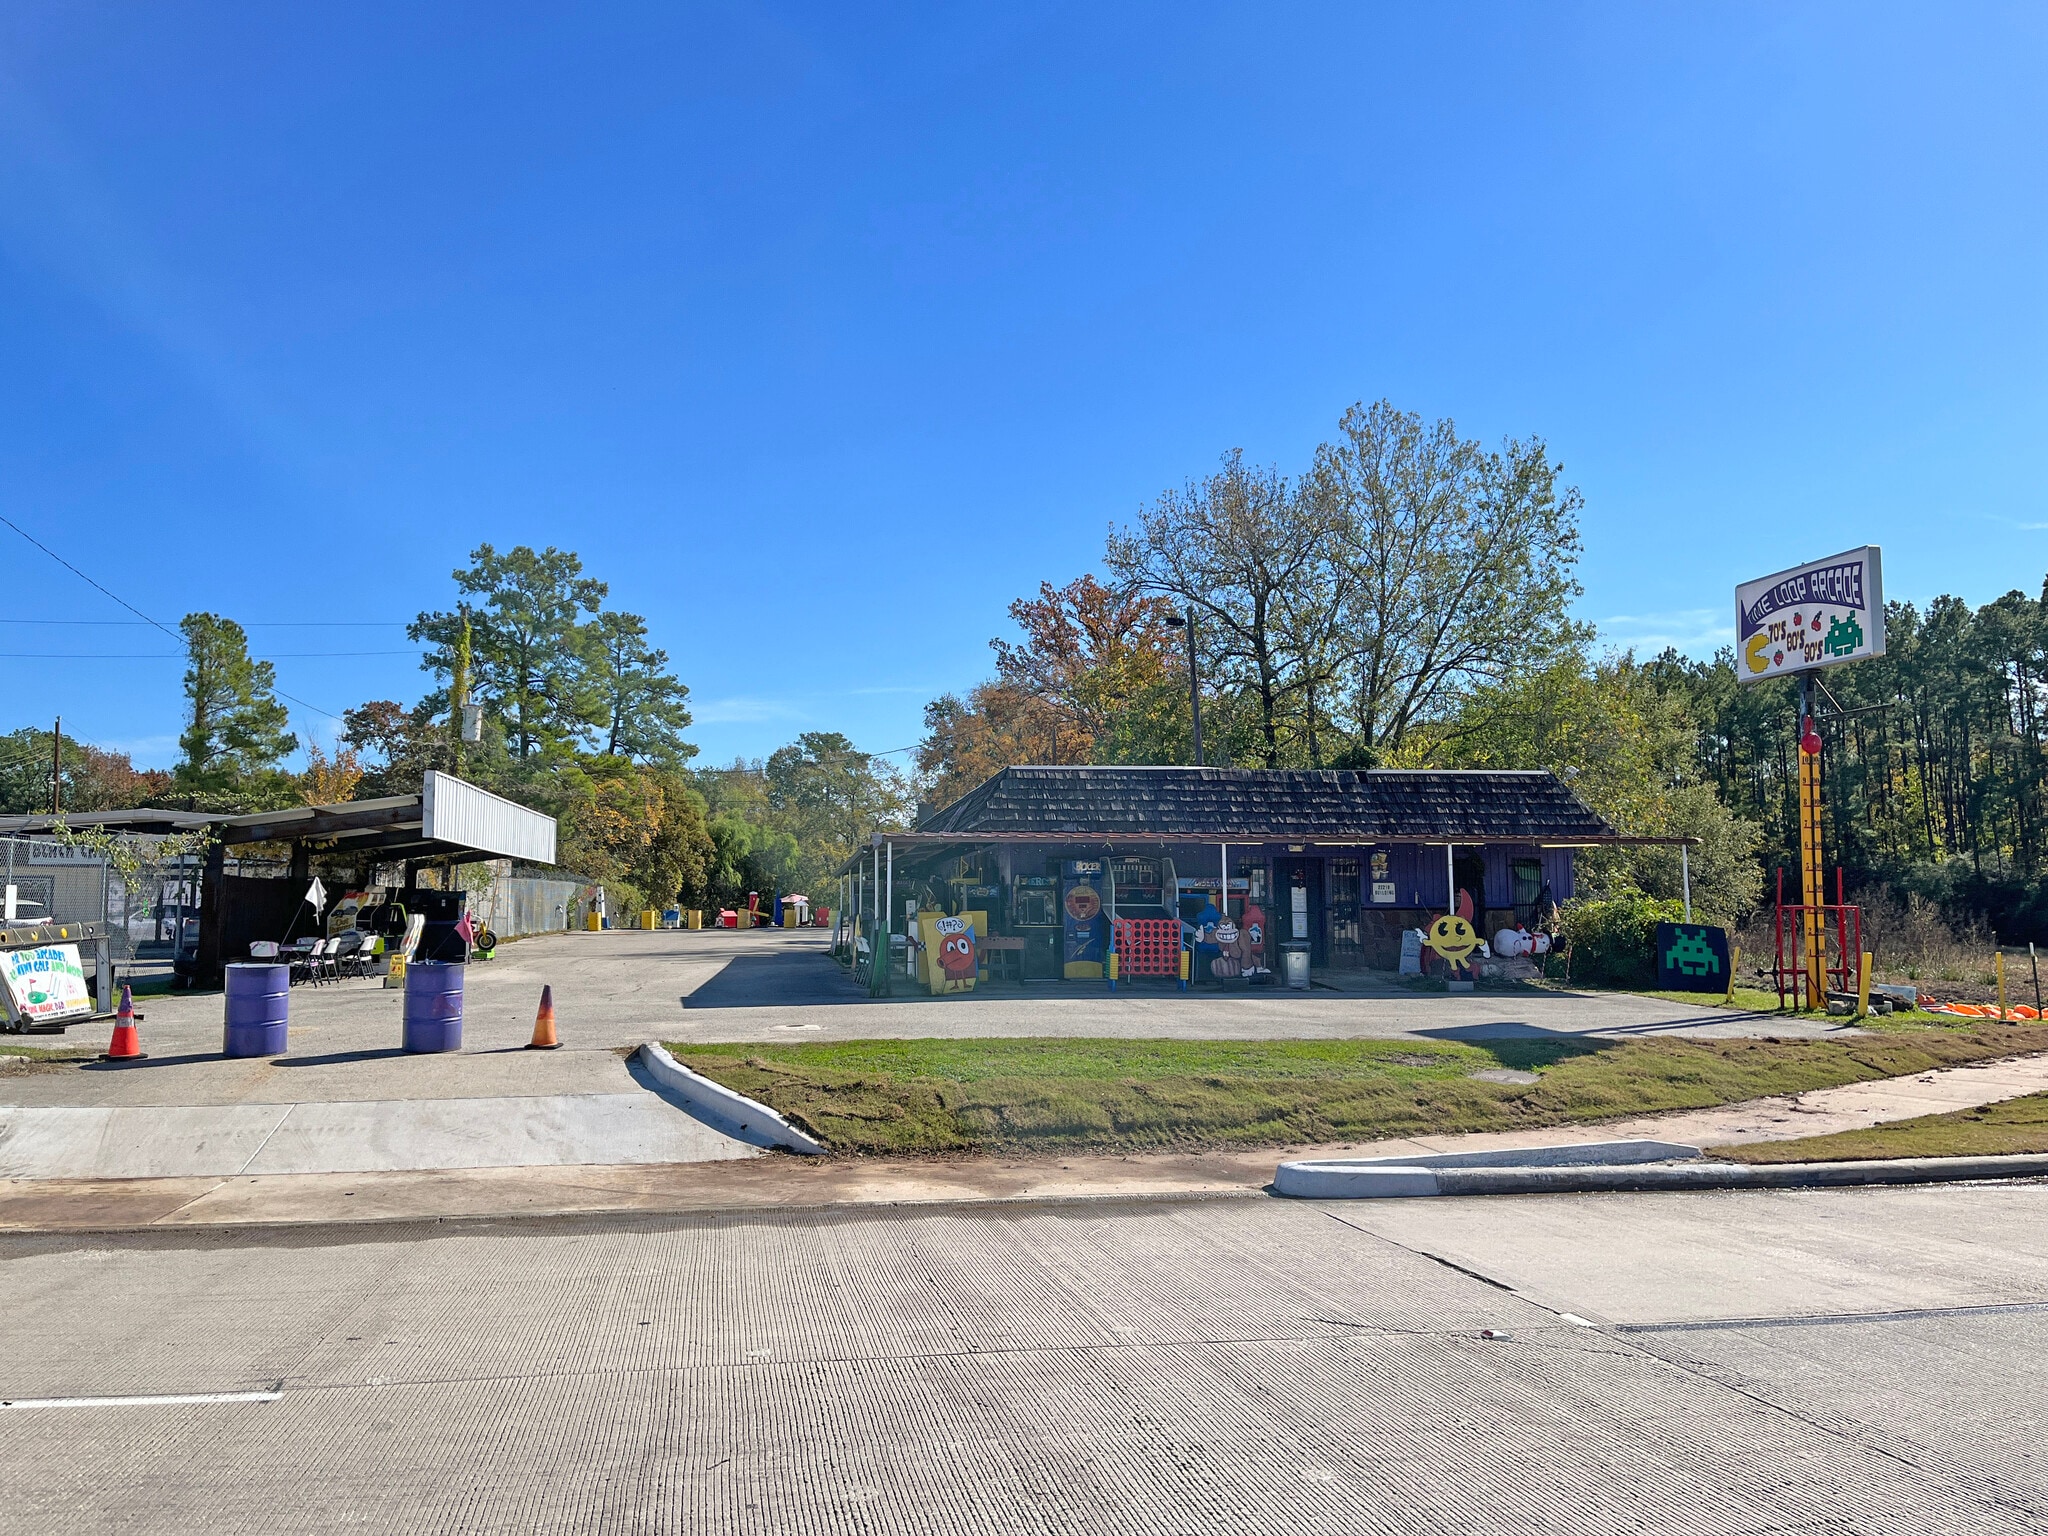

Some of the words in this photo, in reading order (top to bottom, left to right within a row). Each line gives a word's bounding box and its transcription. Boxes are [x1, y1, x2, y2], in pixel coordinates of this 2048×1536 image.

[1748, 595, 1773, 625] TIME
[1774, 576, 1806, 606] LOOP
[1810, 565, 1861, 605] ARCADE
[1768, 620, 1786, 644] 70'S
[1786, 630, 1806, 652] 80'S
[1804, 640, 1824, 663] 90'S
